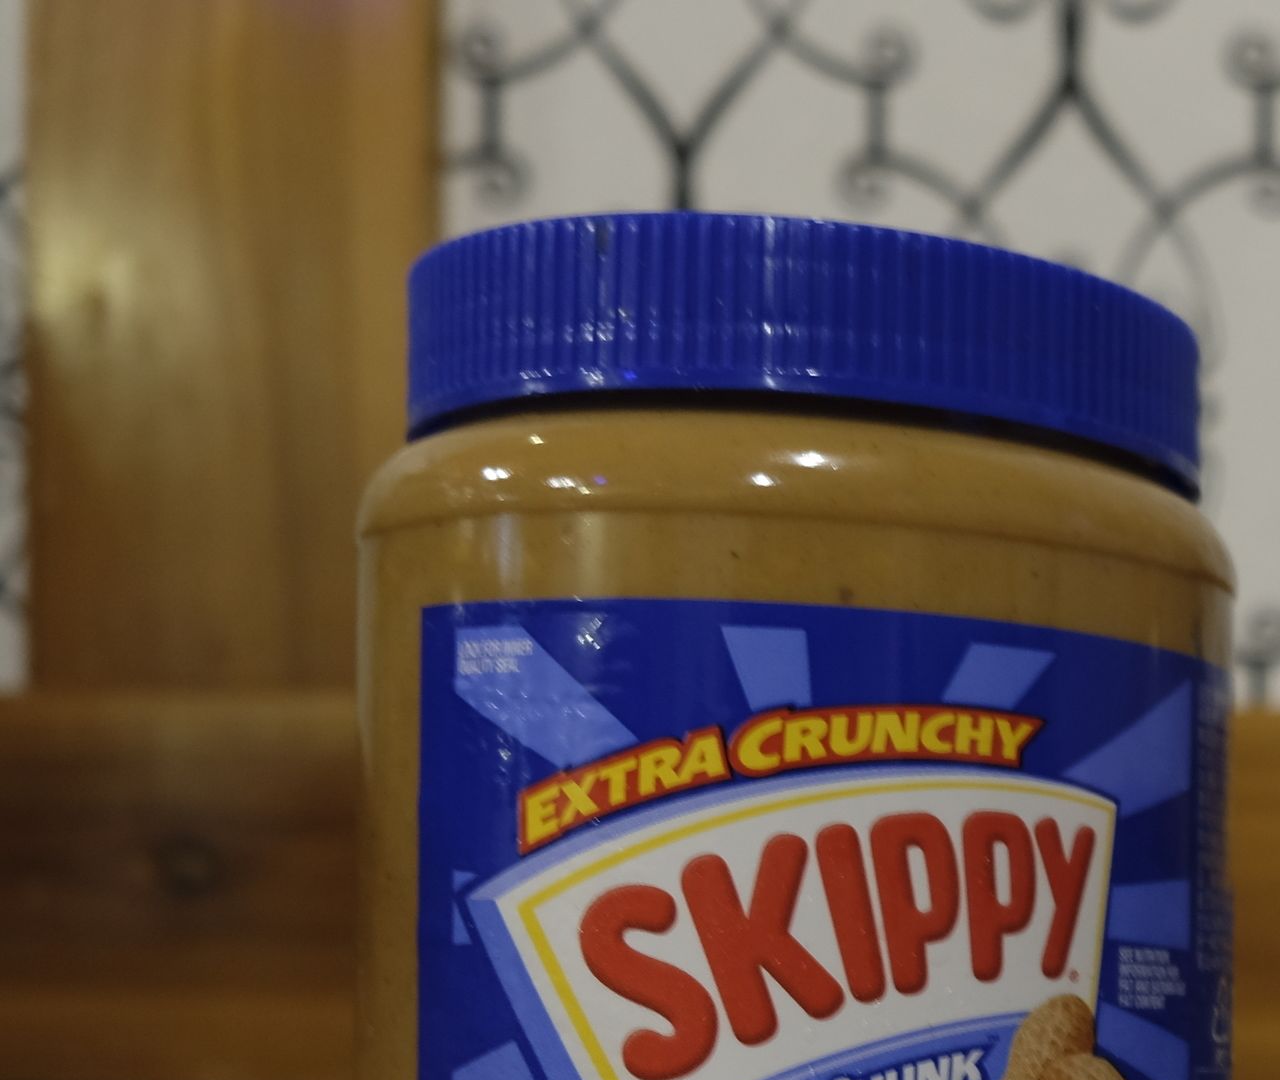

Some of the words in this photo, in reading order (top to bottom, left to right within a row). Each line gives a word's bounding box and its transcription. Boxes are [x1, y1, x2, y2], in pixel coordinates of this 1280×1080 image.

[524, 735, 726, 847] EXTRA
[737, 711, 1036, 773] CRUNCHY
[579, 810, 1098, 1080] SKIPPY
